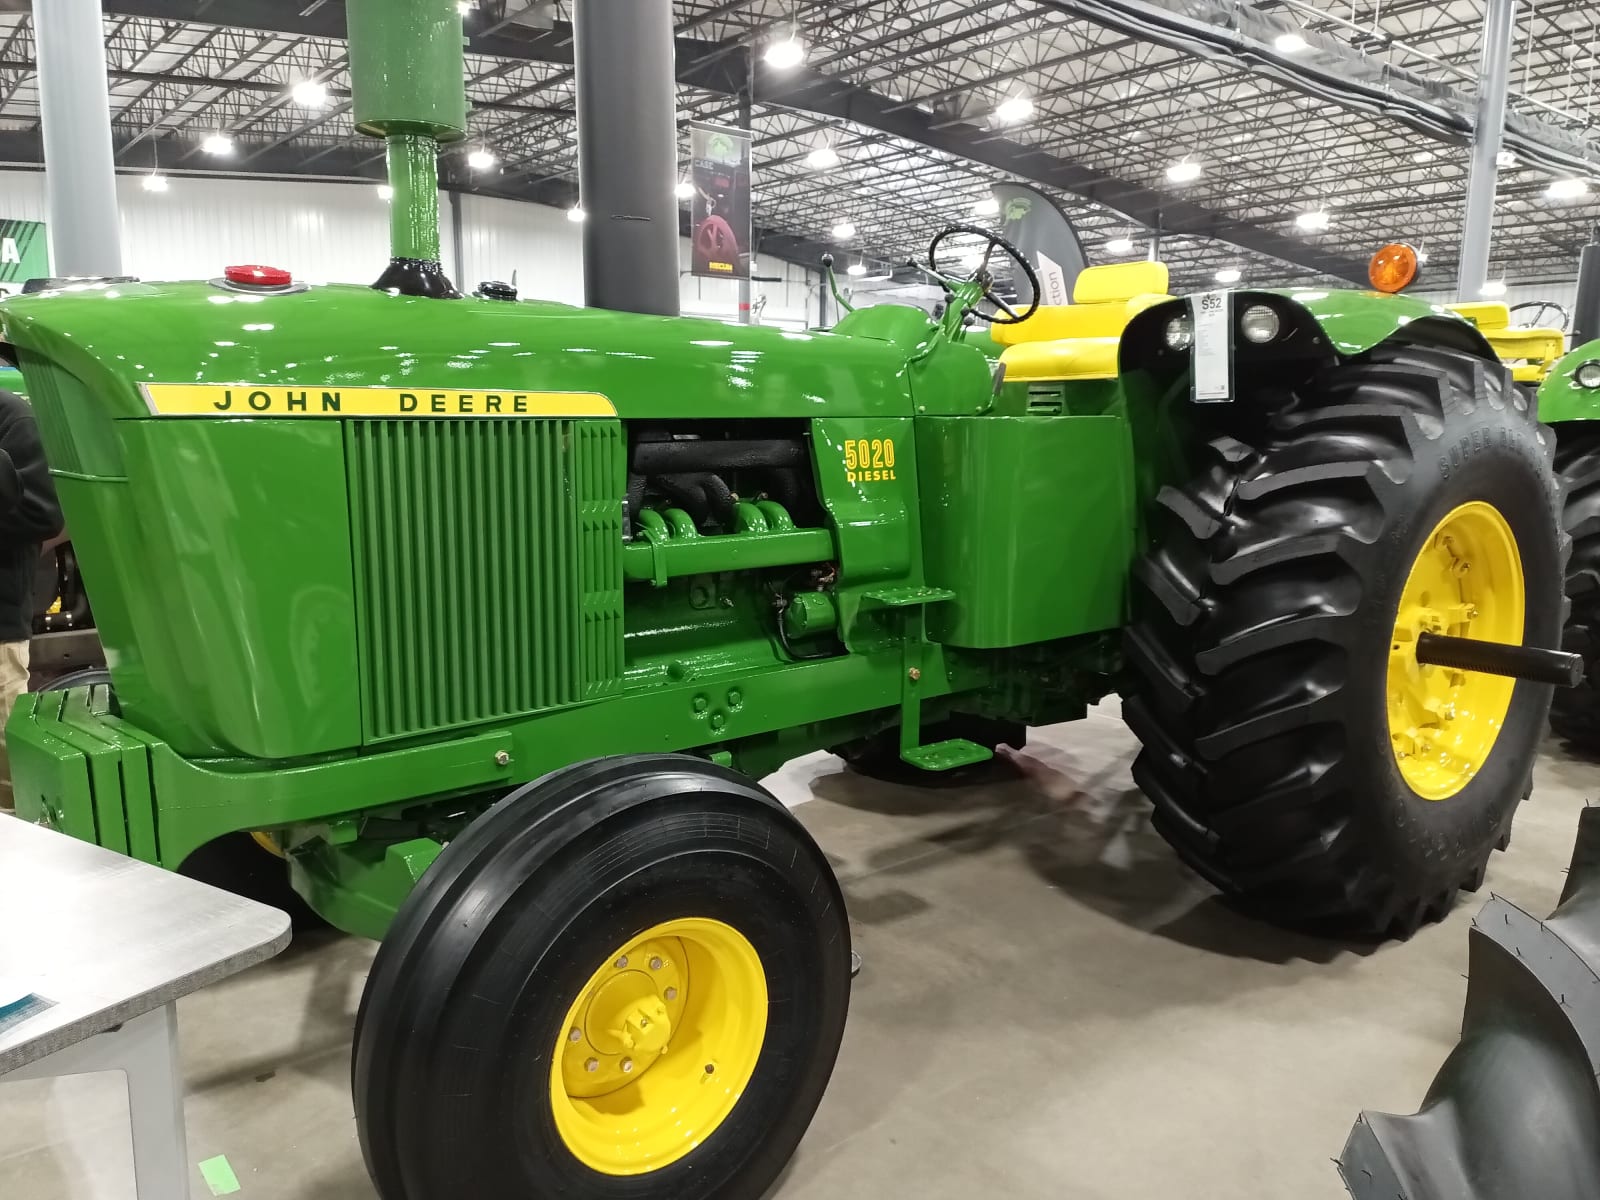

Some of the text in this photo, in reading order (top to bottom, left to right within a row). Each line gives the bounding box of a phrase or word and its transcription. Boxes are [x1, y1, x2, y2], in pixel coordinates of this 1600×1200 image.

[1201, 297, 1222, 310] S52
[213, 390, 528, 413] JOHN DEERE
[844, 438, 895, 470] 5020
[847, 469, 897, 483] DIESEL
